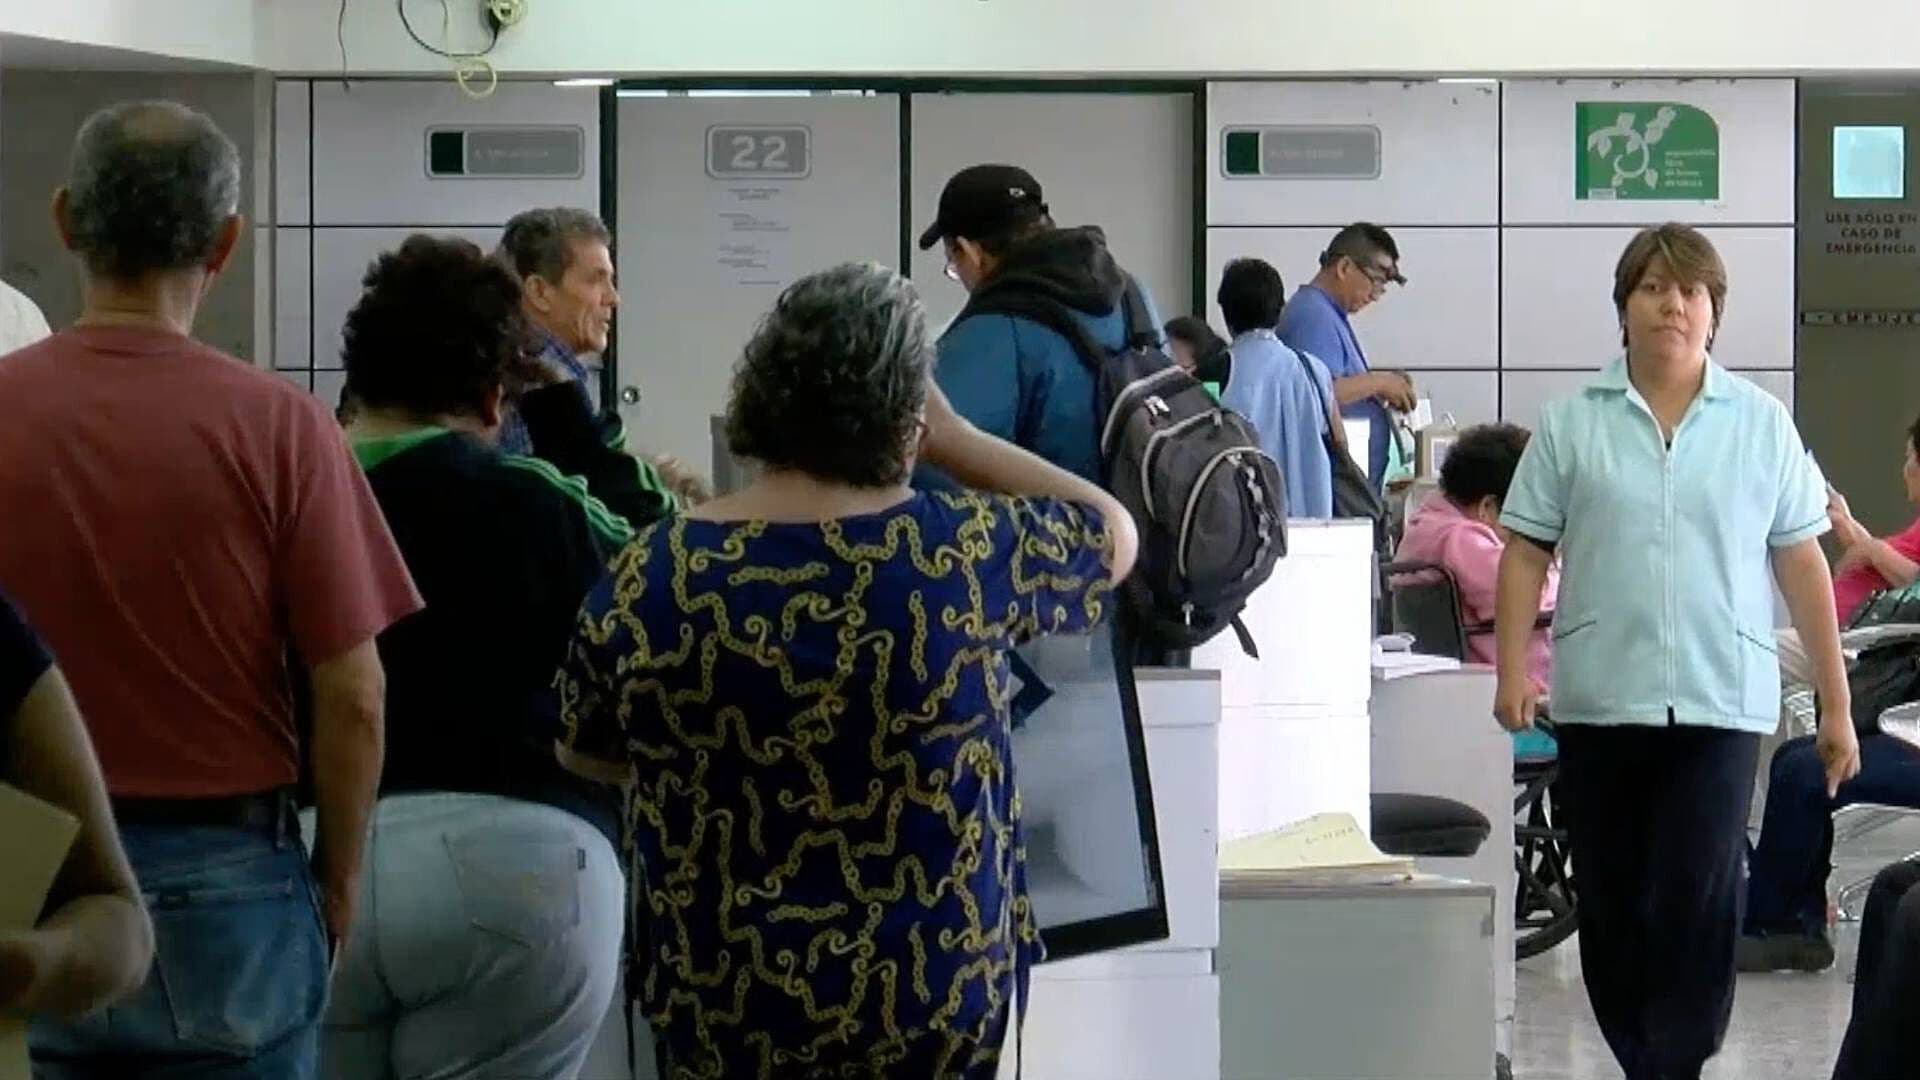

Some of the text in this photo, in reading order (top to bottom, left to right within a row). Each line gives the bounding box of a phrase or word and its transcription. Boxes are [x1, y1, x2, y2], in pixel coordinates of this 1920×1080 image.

[731, 135, 789, 168] 22
[1825, 212, 1850, 224] USE
[1898, 213, 1918, 224] EN
[1840, 227, 1902, 240] CASO DE
[1825, 242, 1917, 254] EMERGENCIA
[1833, 311, 1914, 324] EMPUJE
